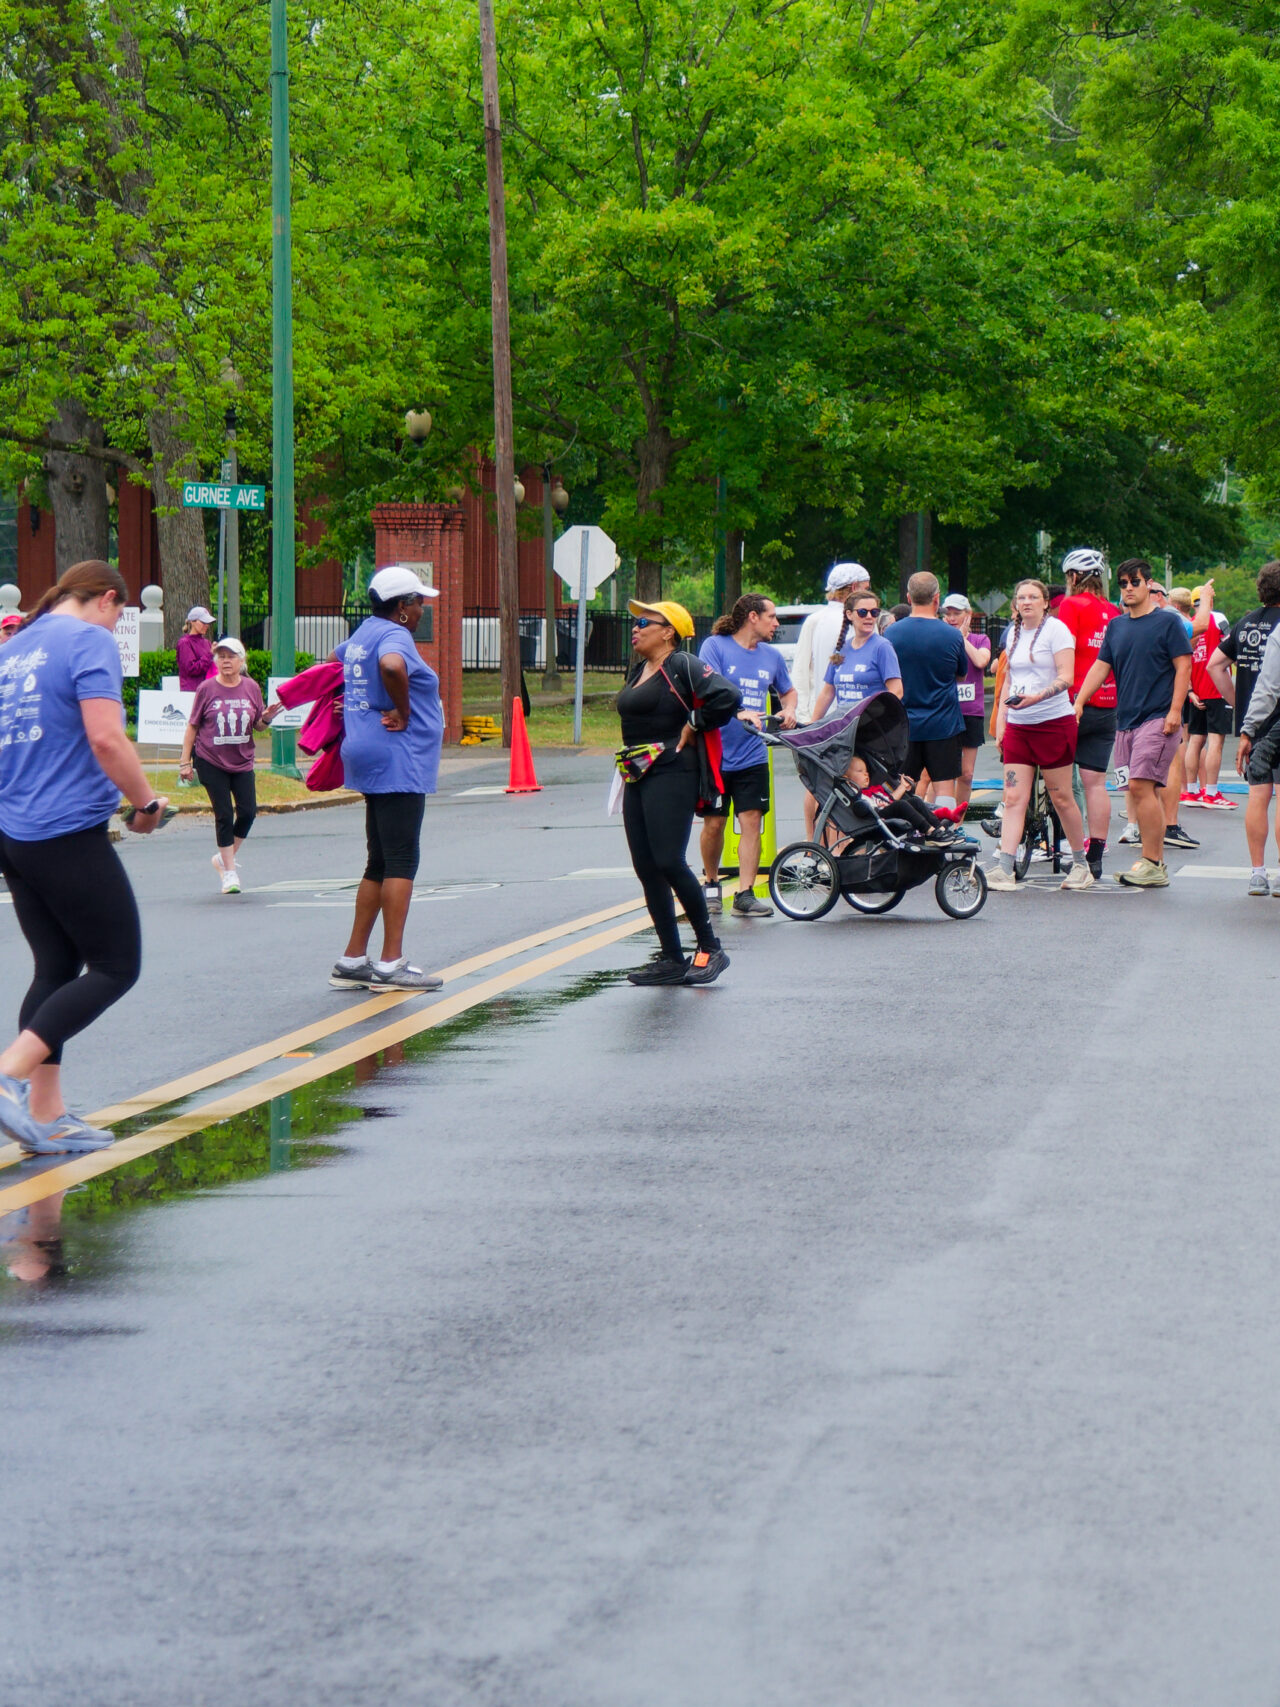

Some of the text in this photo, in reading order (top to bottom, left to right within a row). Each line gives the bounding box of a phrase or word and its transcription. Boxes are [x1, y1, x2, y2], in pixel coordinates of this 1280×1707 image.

[184, 486, 265, 507] GURNEE AVE.
[119, 612, 136, 621] ATE
[114, 625, 137, 635] KING
[119, 653, 136, 662] ONS
